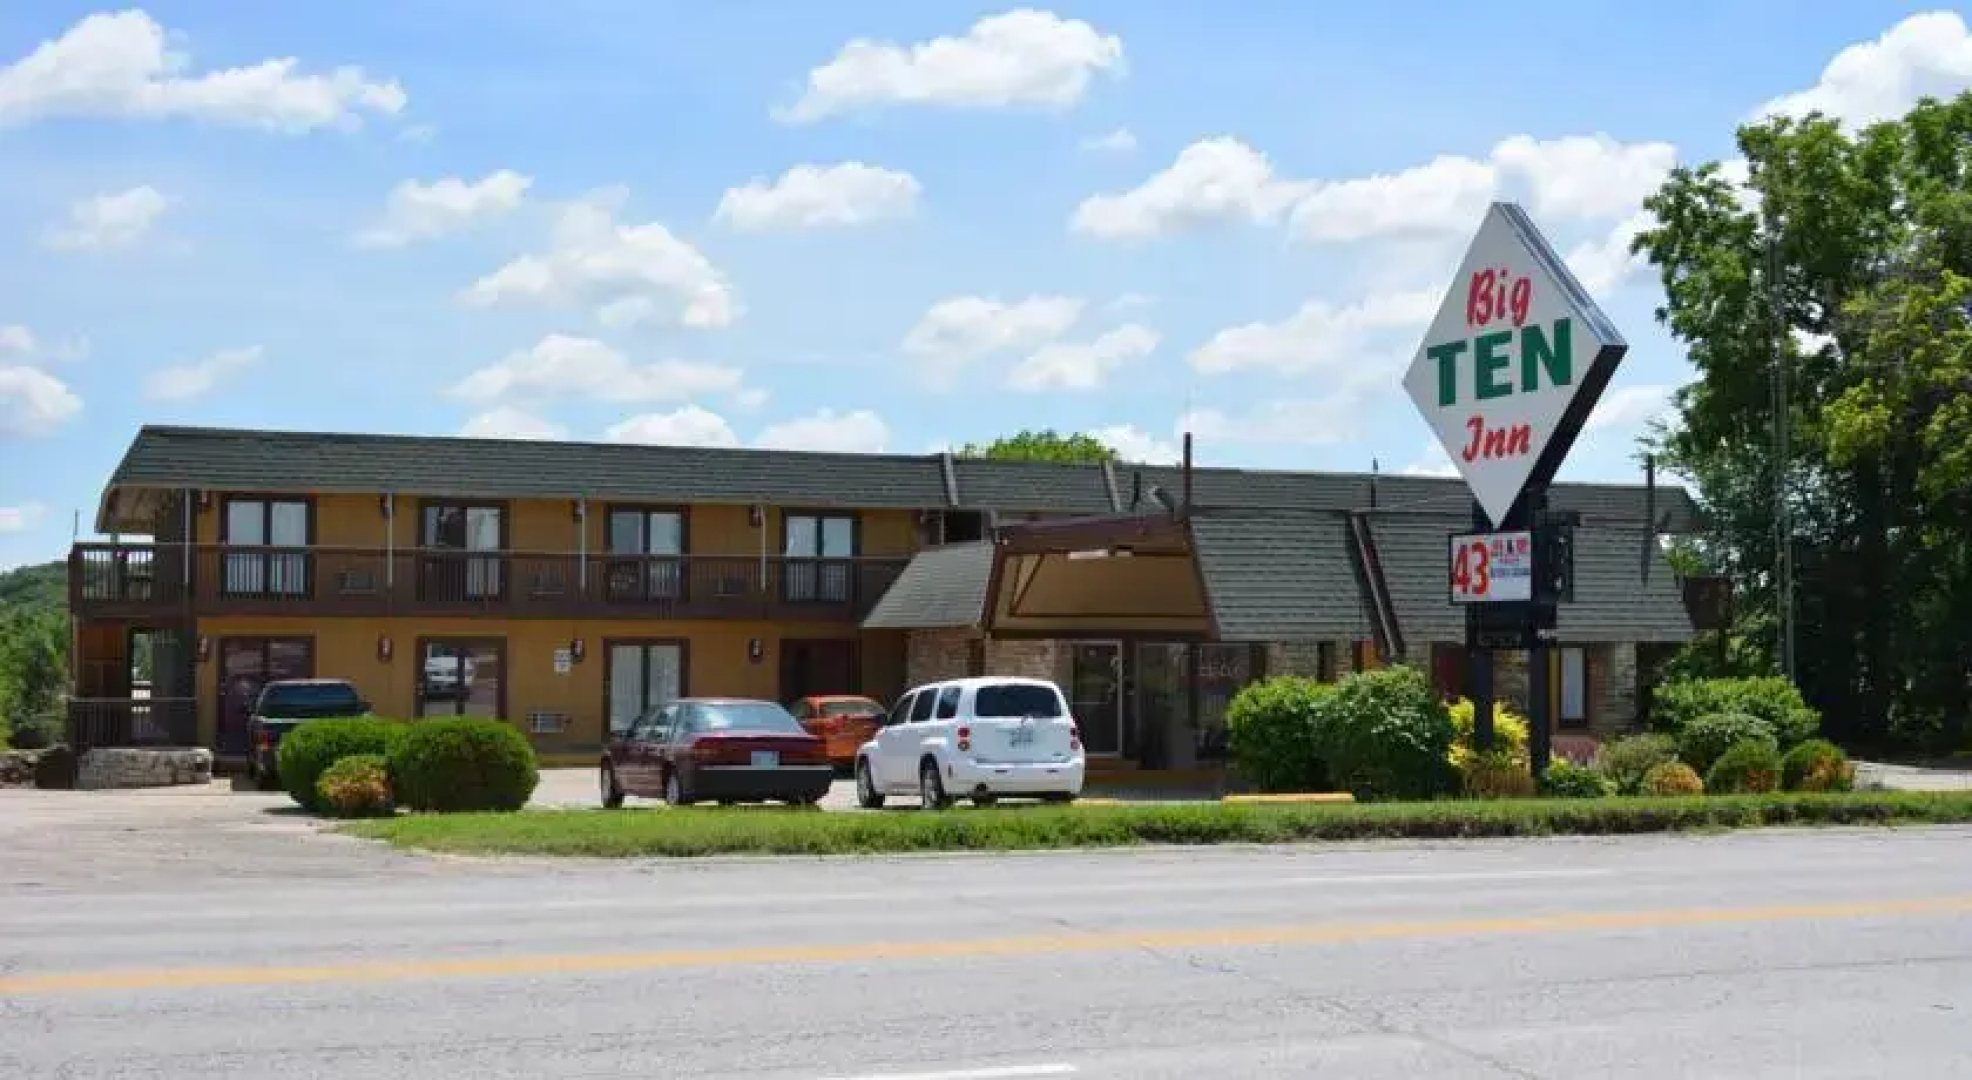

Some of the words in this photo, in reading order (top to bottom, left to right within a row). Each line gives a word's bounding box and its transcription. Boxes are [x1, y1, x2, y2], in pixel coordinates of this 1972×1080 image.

[1466, 268, 1531, 327] Big
[1427, 317, 1571, 407] TEN
[1462, 414, 1531, 462] Inn
[1451, 541, 1488, 595] 43
